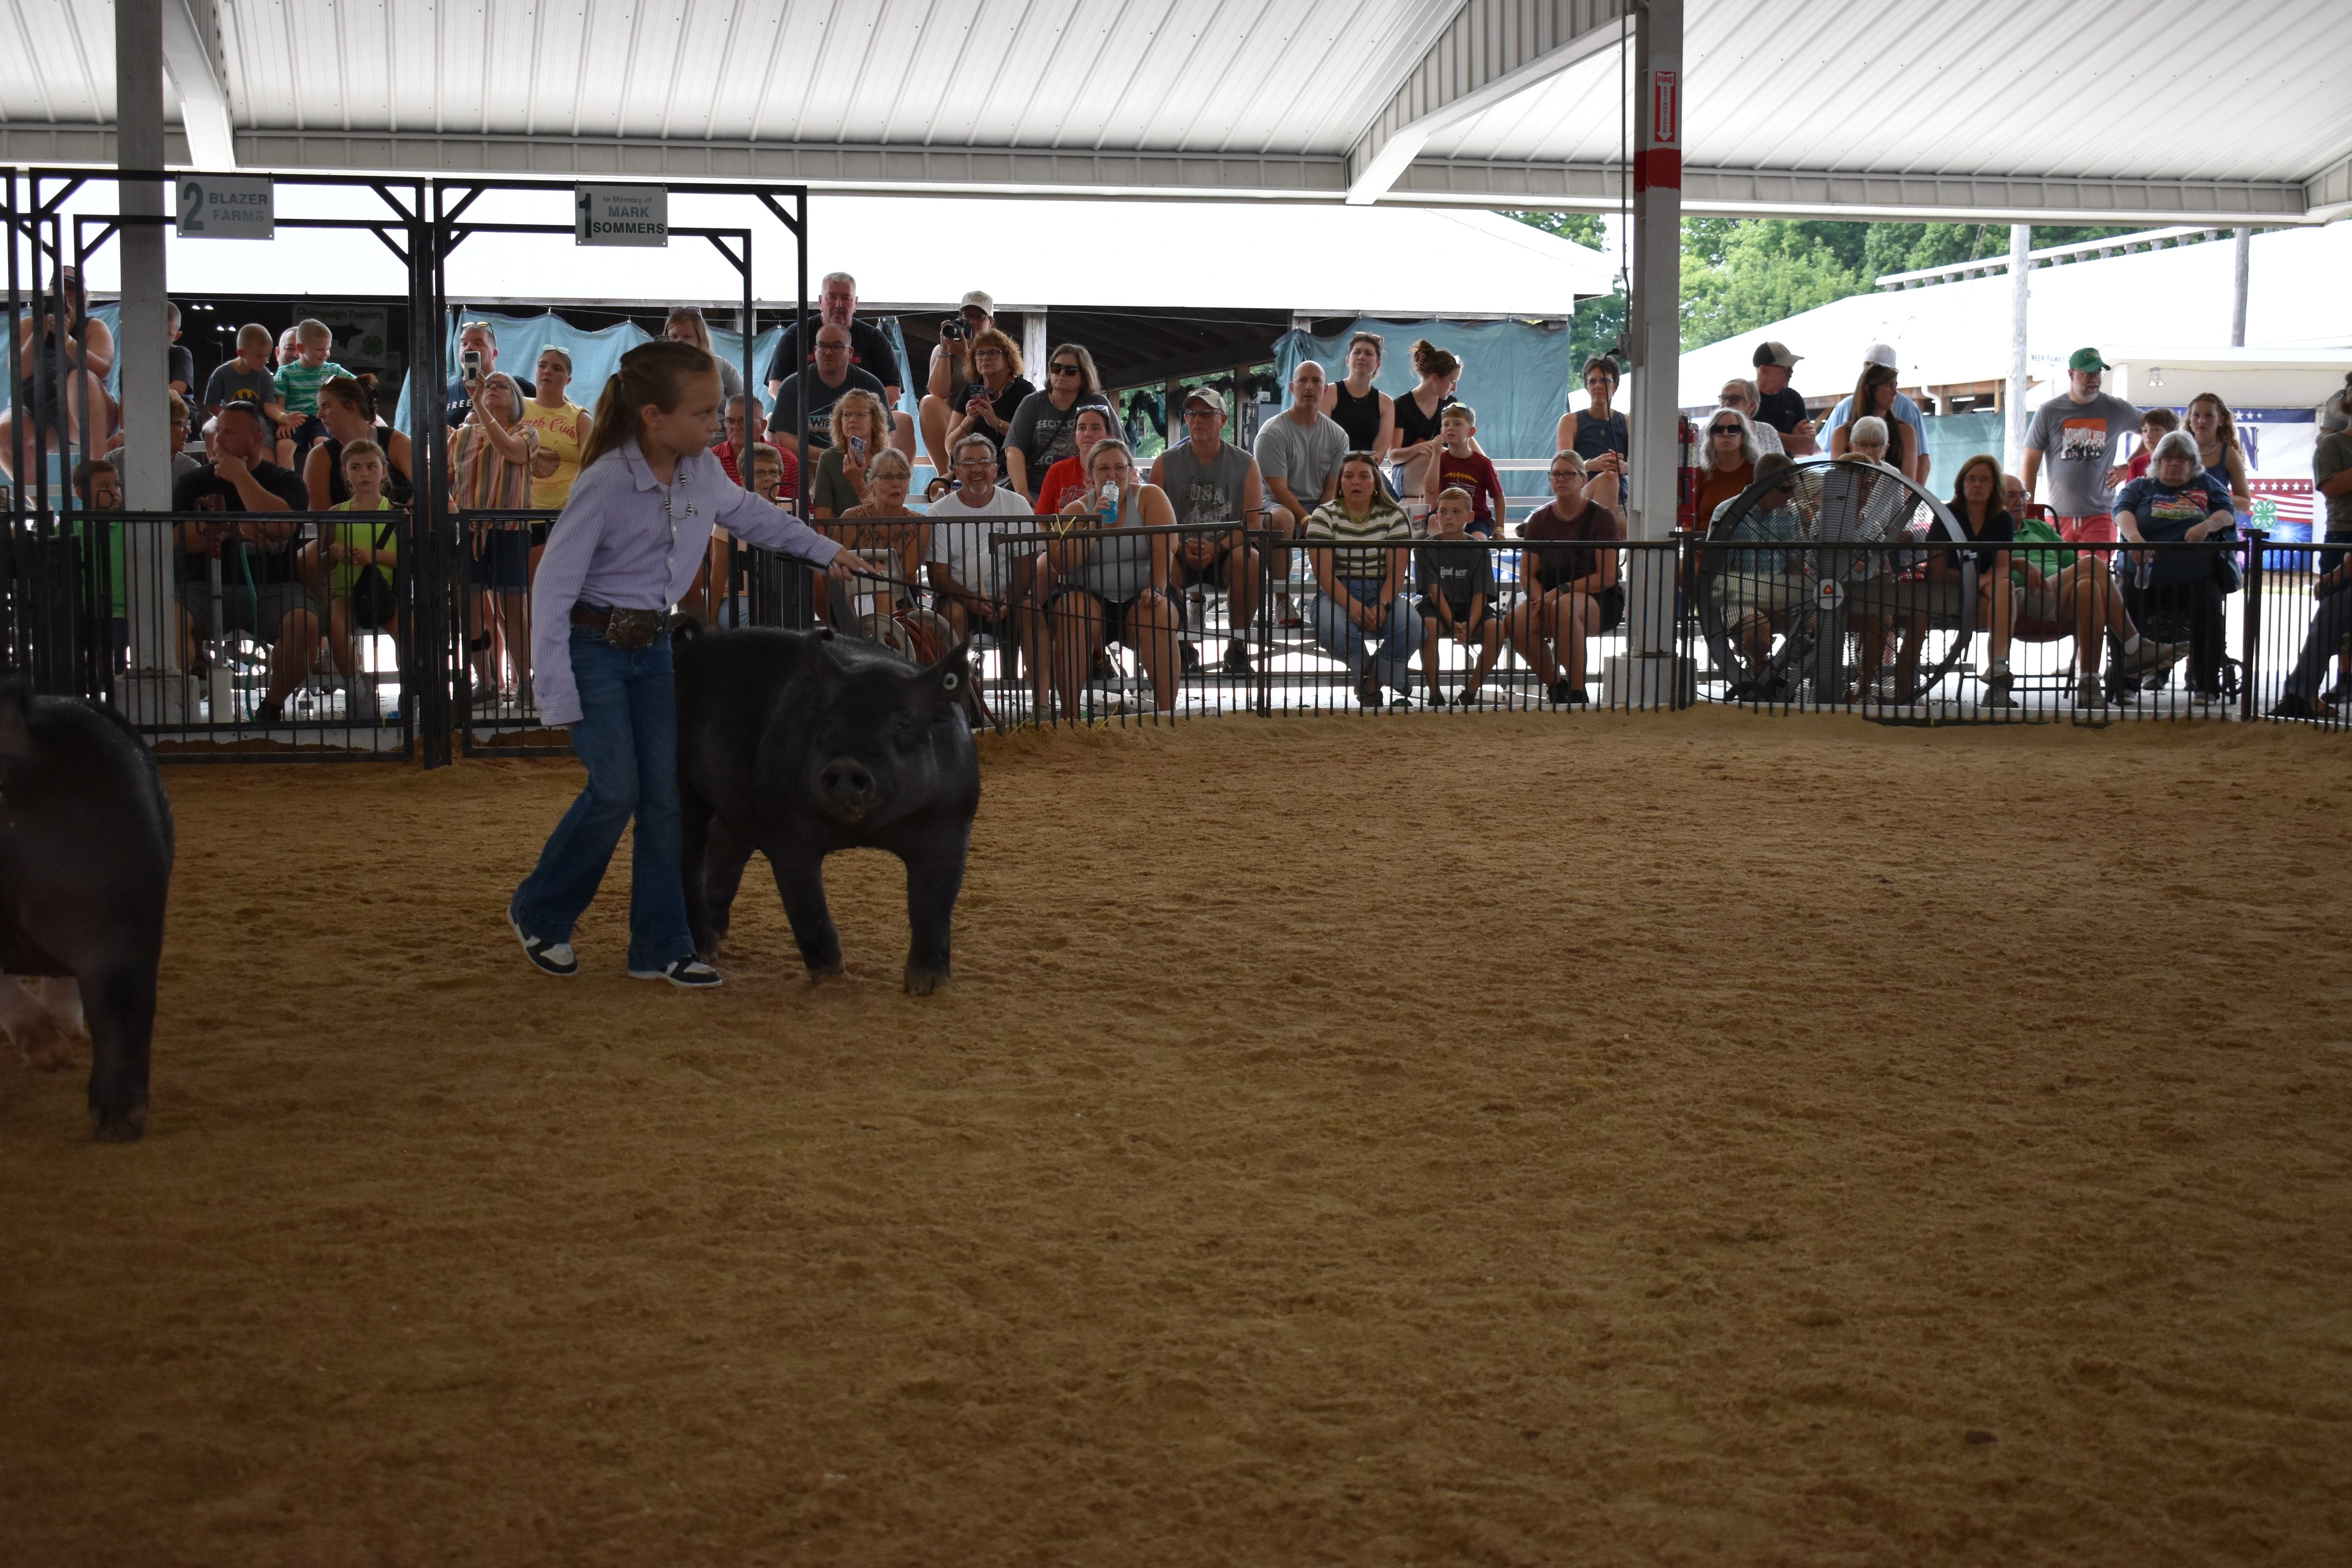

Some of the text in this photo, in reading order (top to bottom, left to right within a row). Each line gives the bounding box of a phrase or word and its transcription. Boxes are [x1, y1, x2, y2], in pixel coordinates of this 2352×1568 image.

[209, 193, 268, 205] BLAZER
[183, 182, 204, 230] 2
[608, 206, 649, 218] MARK
[213, 209, 265, 222] FARMS
[579, 193, 592, 238] 1
[593, 222, 665, 234] SOMMERS
[296, 307, 383, 320] Champaign Feeders
[550, 418, 576, 439] Club
[1190, 484, 1225, 504] USA
